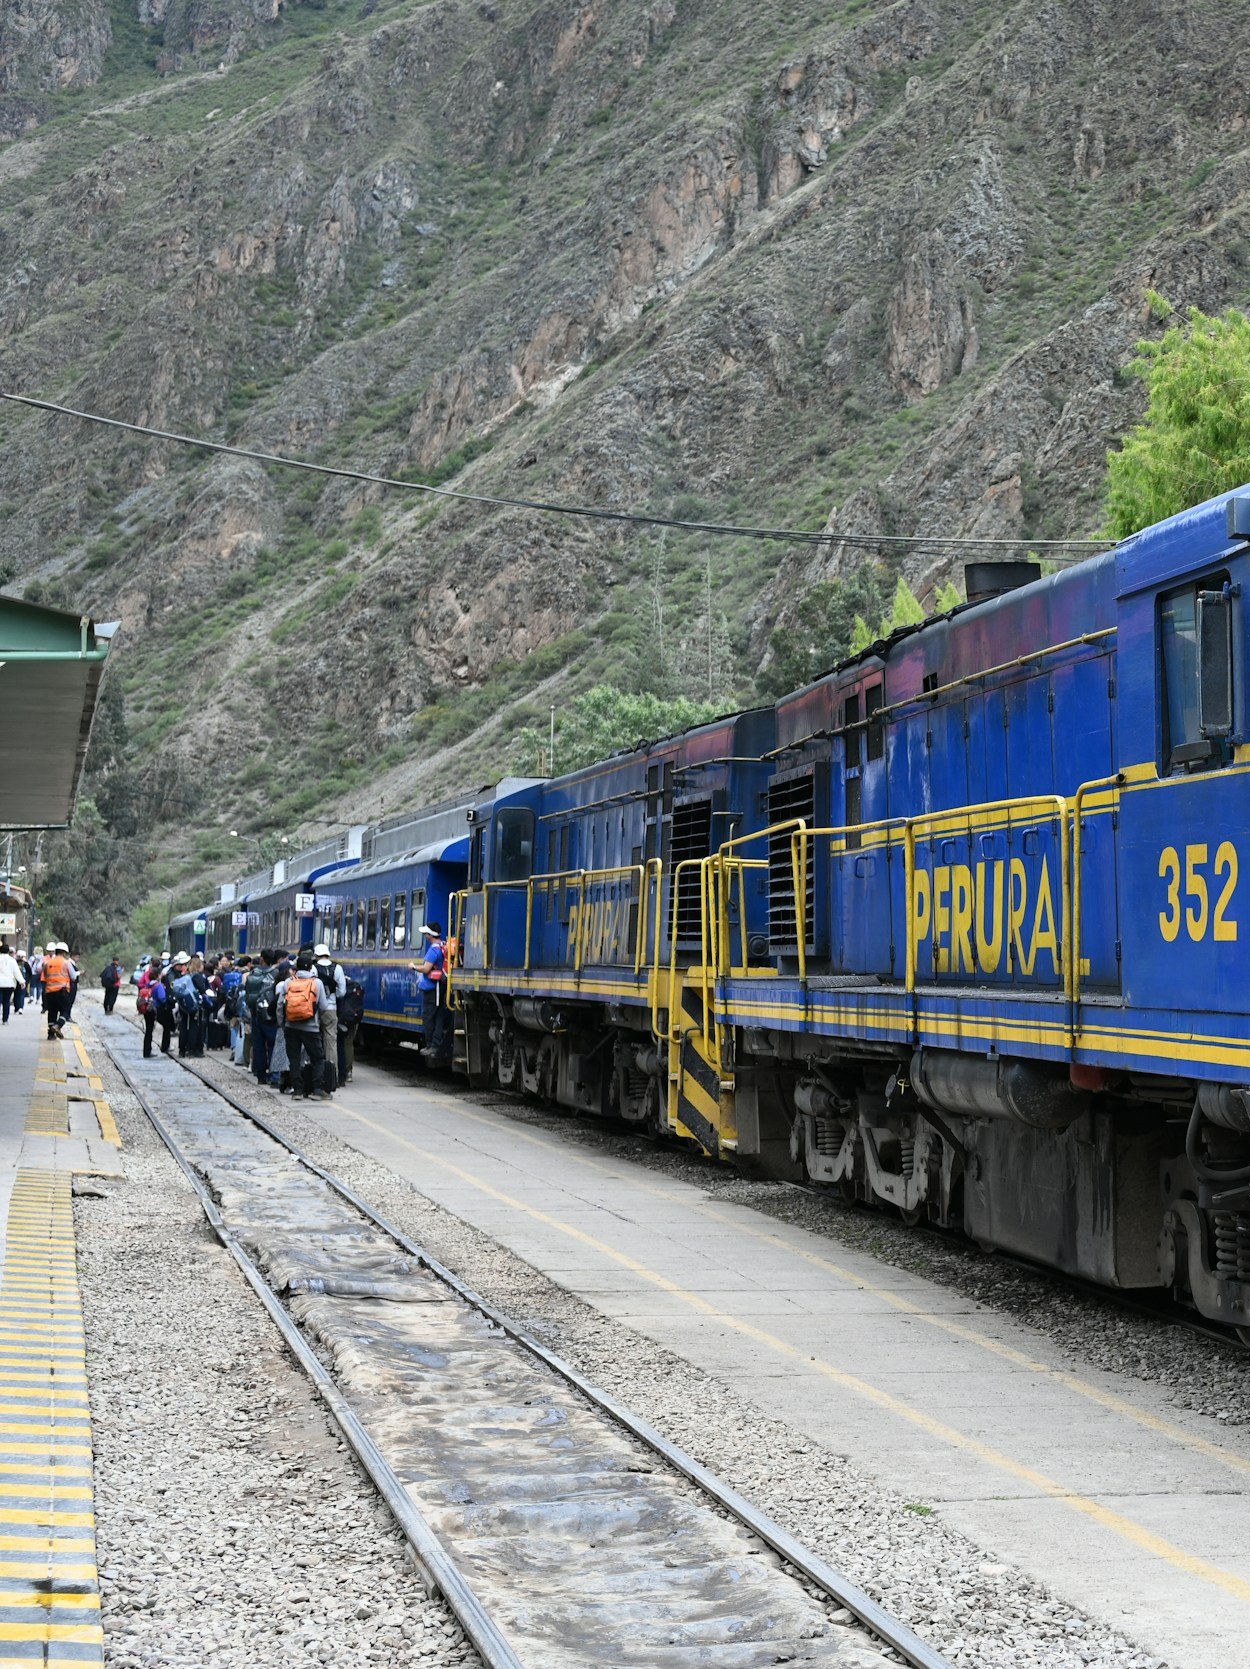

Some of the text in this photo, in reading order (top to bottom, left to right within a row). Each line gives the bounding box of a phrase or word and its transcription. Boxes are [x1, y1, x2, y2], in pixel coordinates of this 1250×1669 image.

[1159, 841, 1238, 942] 352
[300, 896, 310, 910] F
[235, 913, 244, 924] E
[196, 921, 204, 930] A
